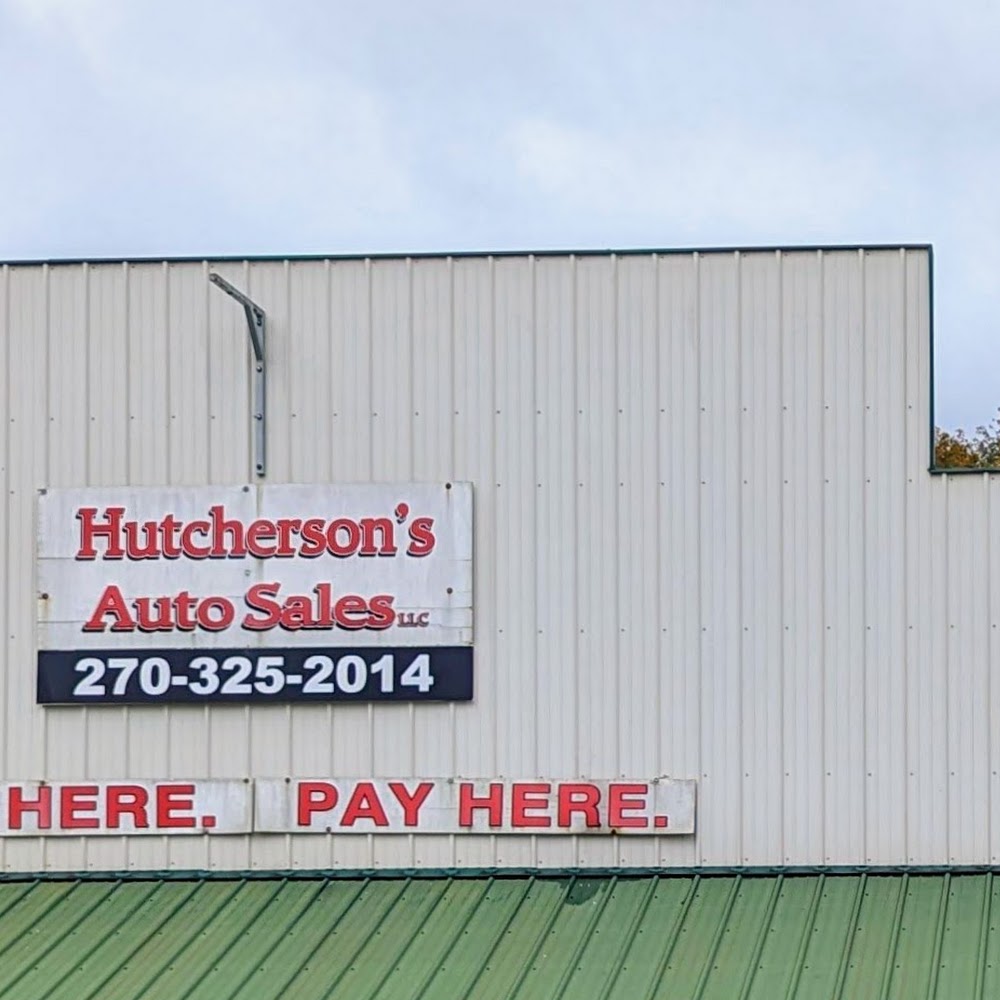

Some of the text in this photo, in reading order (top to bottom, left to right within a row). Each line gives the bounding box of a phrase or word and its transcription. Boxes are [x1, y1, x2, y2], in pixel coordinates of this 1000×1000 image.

[75, 503, 436, 560] Hutcherson's
[83, 582, 430, 632] Auto Sales LLC
[74, 654, 434, 696] 270-325-2014
[8, 785, 216, 829] HERE.
[298, 783, 669, 828] PAY HERE.
